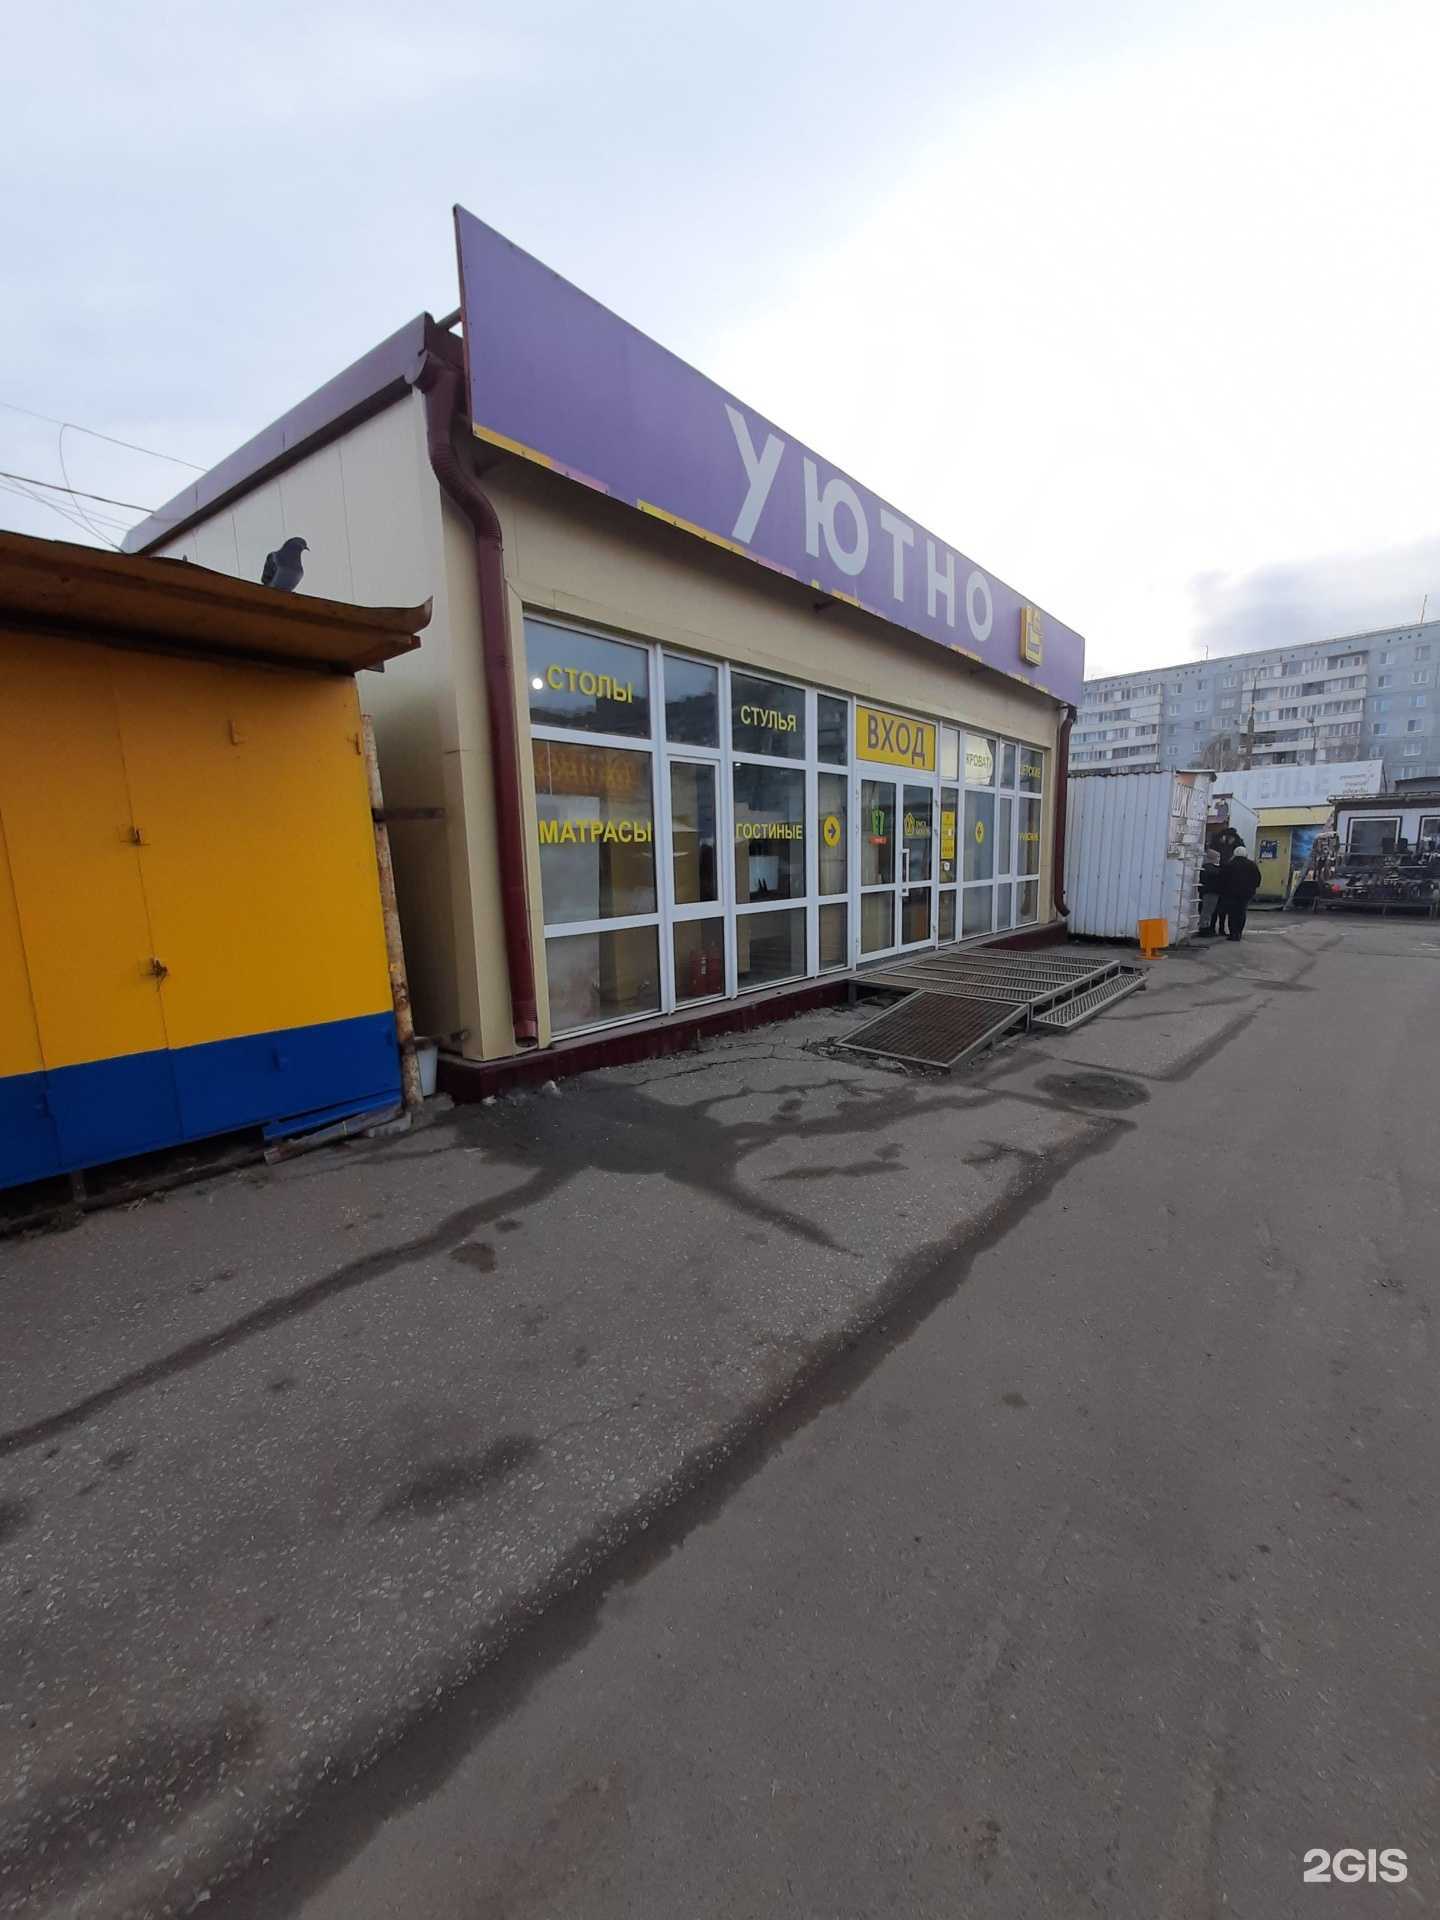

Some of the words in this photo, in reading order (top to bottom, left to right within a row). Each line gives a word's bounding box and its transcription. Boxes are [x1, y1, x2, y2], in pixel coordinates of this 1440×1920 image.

[725, 403, 993, 642] УЮТНО
[547, 664, 633, 703] СТОЛЫ
[740, 705, 796, 731] СТУЛЬЯ
[867, 714, 925, 767] ВХОД
[539, 820, 652, 843] МАТРАСЫ
[736, 822, 803, 841] ГОСТИНЫЕ
